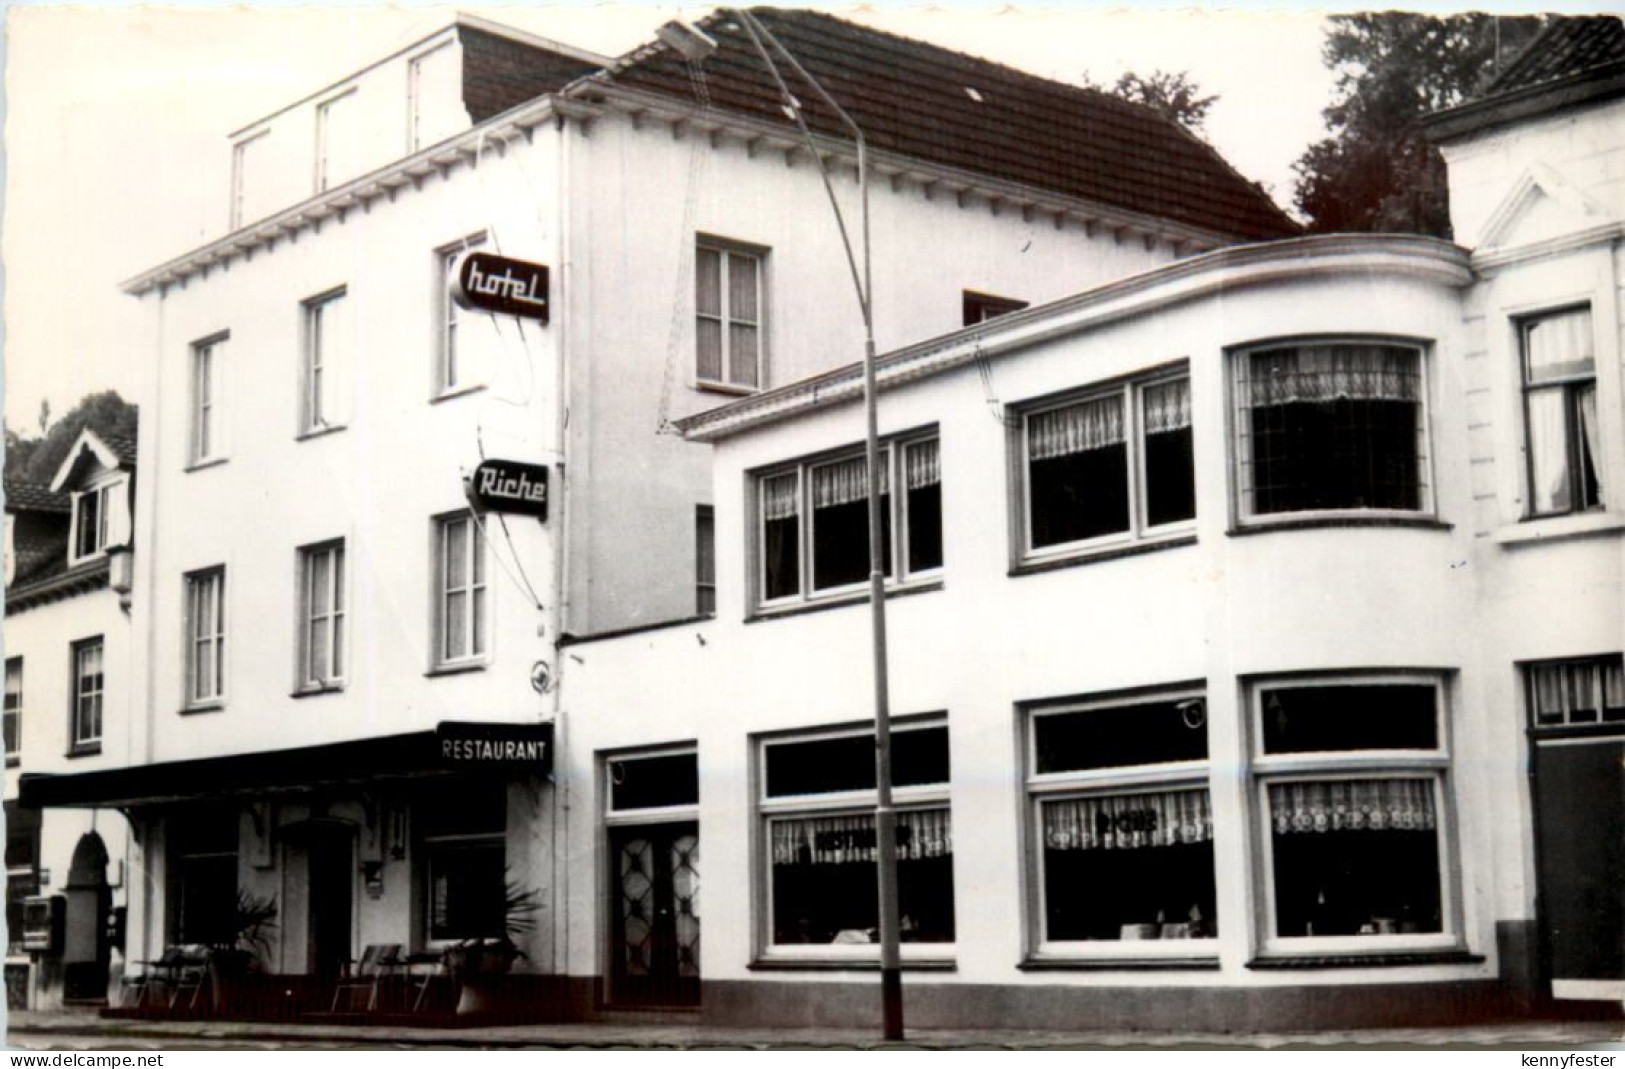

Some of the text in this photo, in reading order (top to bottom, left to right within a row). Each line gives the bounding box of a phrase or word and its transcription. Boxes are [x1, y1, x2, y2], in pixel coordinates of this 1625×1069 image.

[468, 261, 546, 305] hotel
[479, 466, 546, 501] Riche
[442, 739, 546, 760] RESTAURANT
